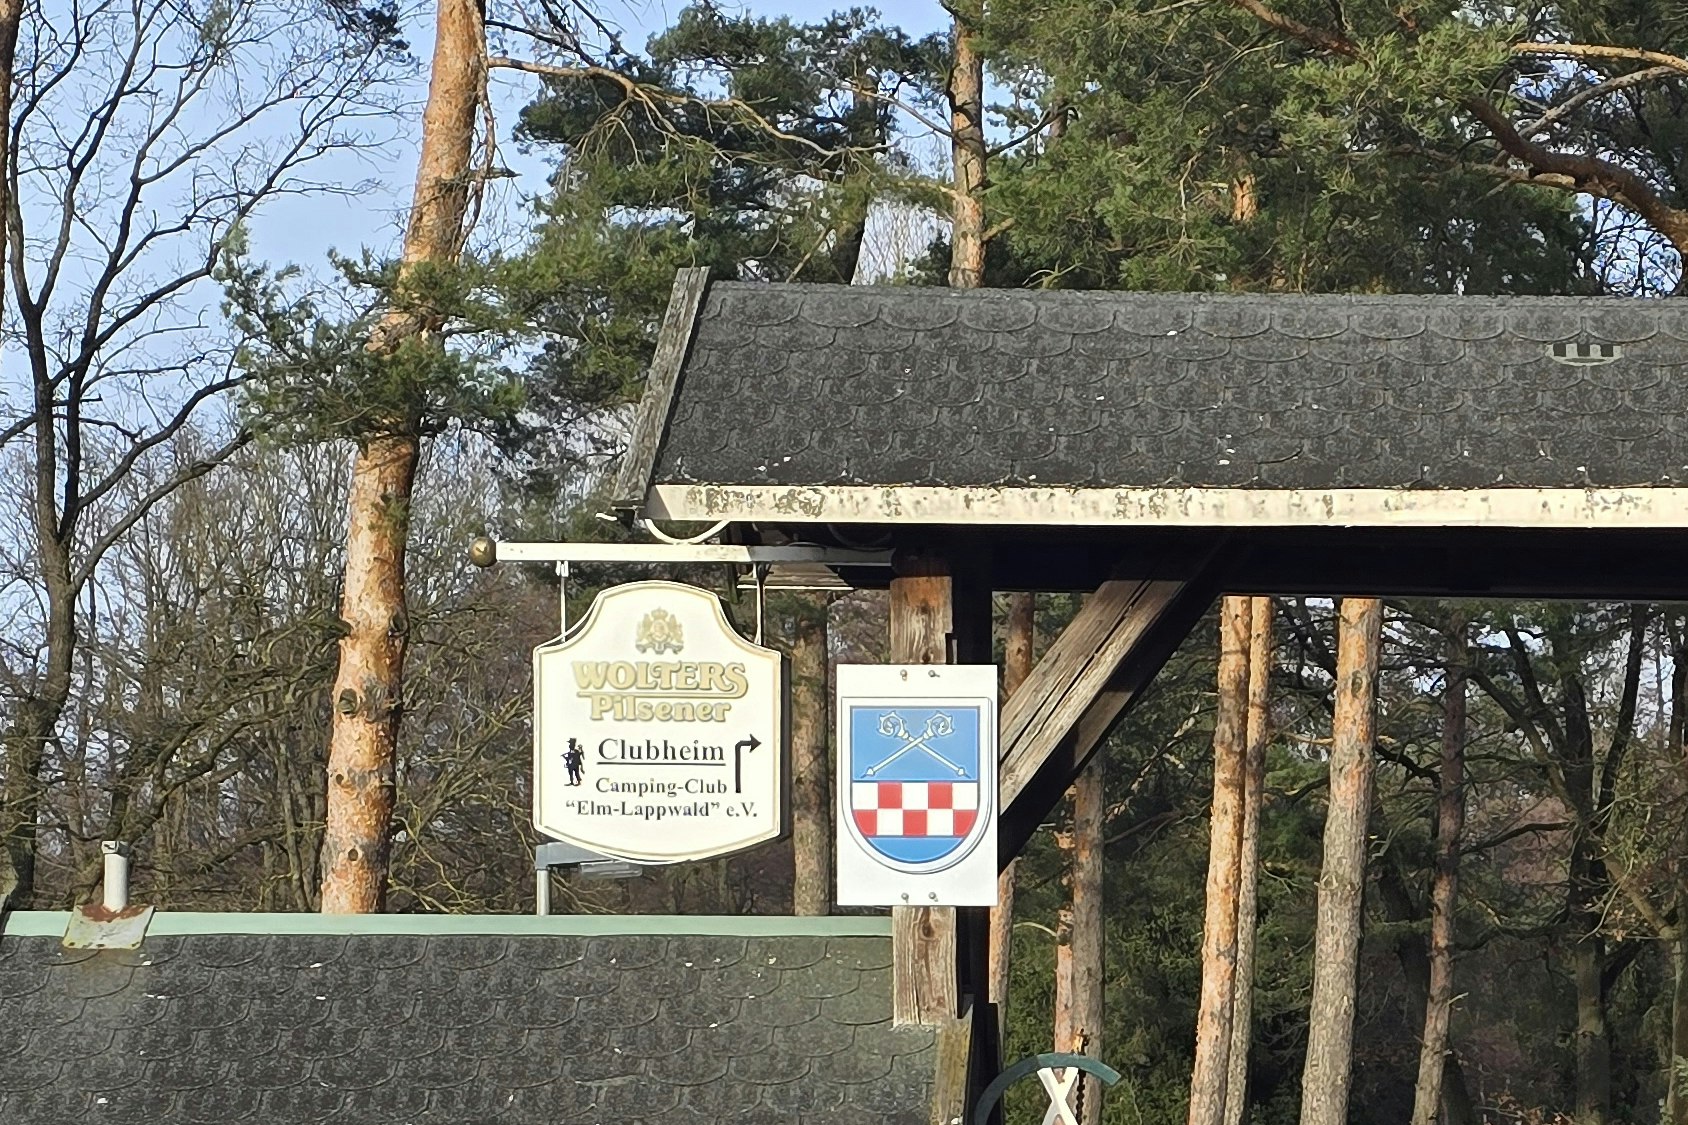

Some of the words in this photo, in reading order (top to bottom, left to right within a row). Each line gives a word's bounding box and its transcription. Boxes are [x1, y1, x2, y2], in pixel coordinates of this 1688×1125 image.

[571, 660, 749, 698] WOLTERS
[590, 694, 732, 722] Pilsener
[597, 738, 725, 761] Clubheim
[595, 777, 728, 798] Camping-Club
[726, 802, 758, 817] e.V.
